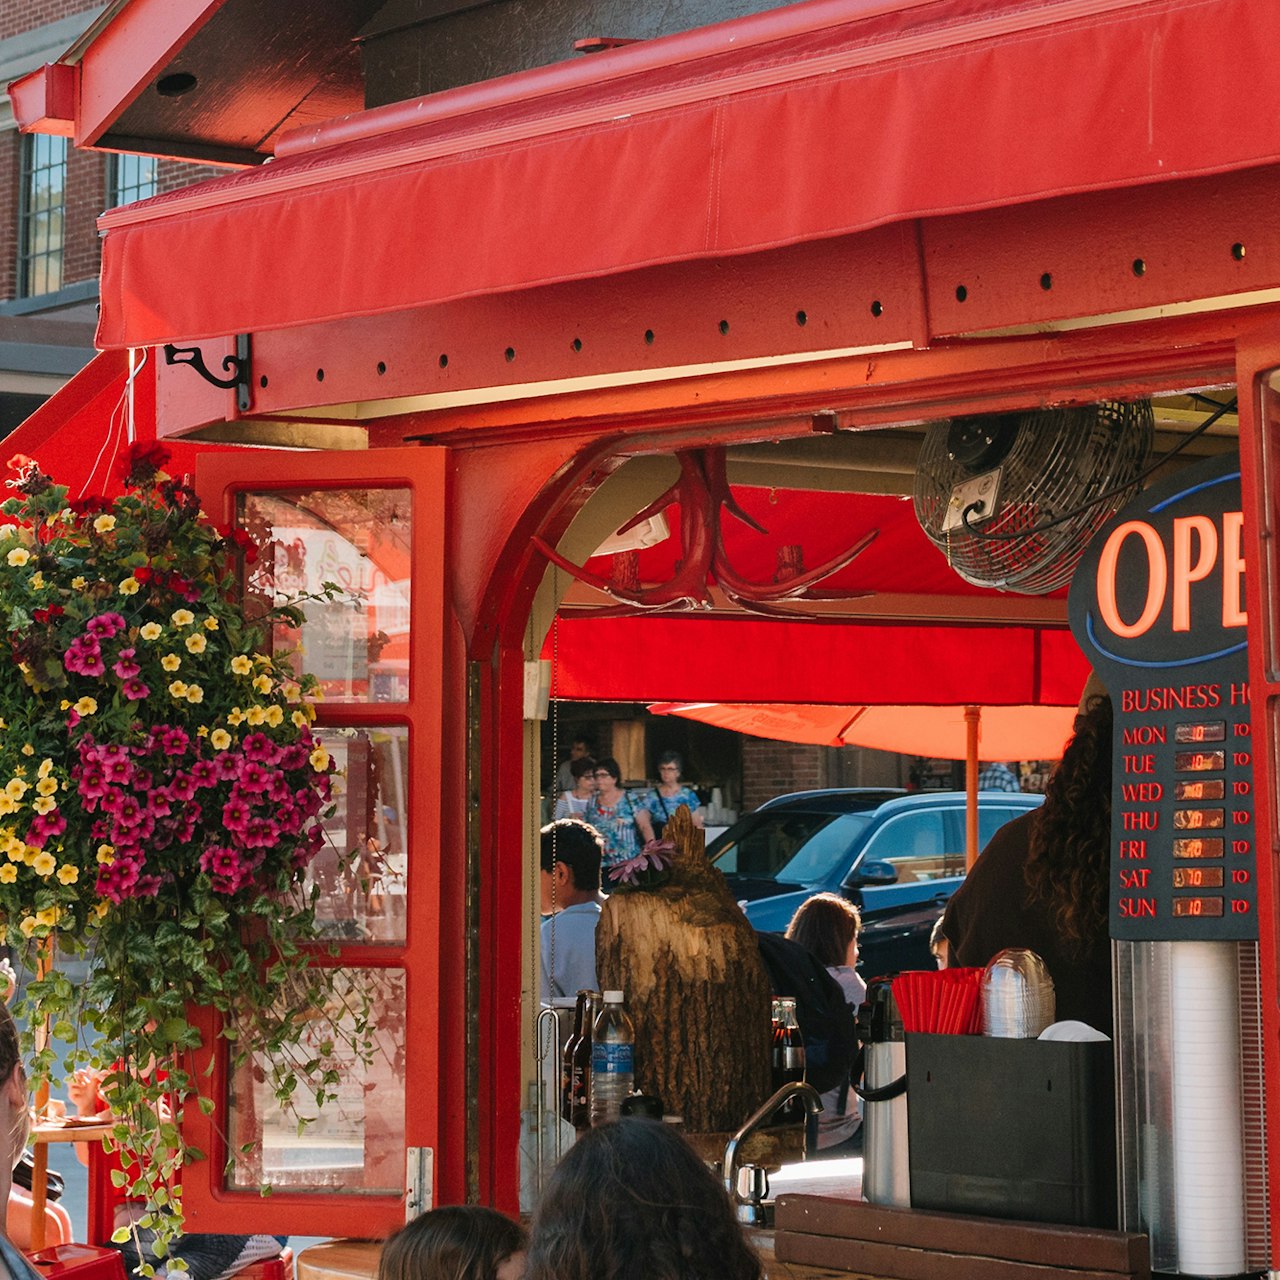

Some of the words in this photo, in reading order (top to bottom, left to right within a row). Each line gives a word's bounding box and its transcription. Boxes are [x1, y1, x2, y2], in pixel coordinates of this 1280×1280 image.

[1121, 683, 1221, 713] BUSINESS
[1122, 724, 1167, 746] MON
[1232, 723, 1251, 737] TO
[1121, 753, 1156, 774] TUE
[1232, 751, 1251, 766] TO
[1121, 782, 1164, 803] WED
[1232, 781, 1251, 795] TO
[1121, 810, 1160, 831] THU
[1231, 810, 1251, 825] TO
[1119, 839, 1147, 860] FRI
[1231, 839, 1251, 854] TO
[1119, 868, 1152, 889] SAT
[1231, 869, 1251, 884] TO
[1118, 897, 1156, 918] SUN
[1230, 898, 1250, 914] TO
